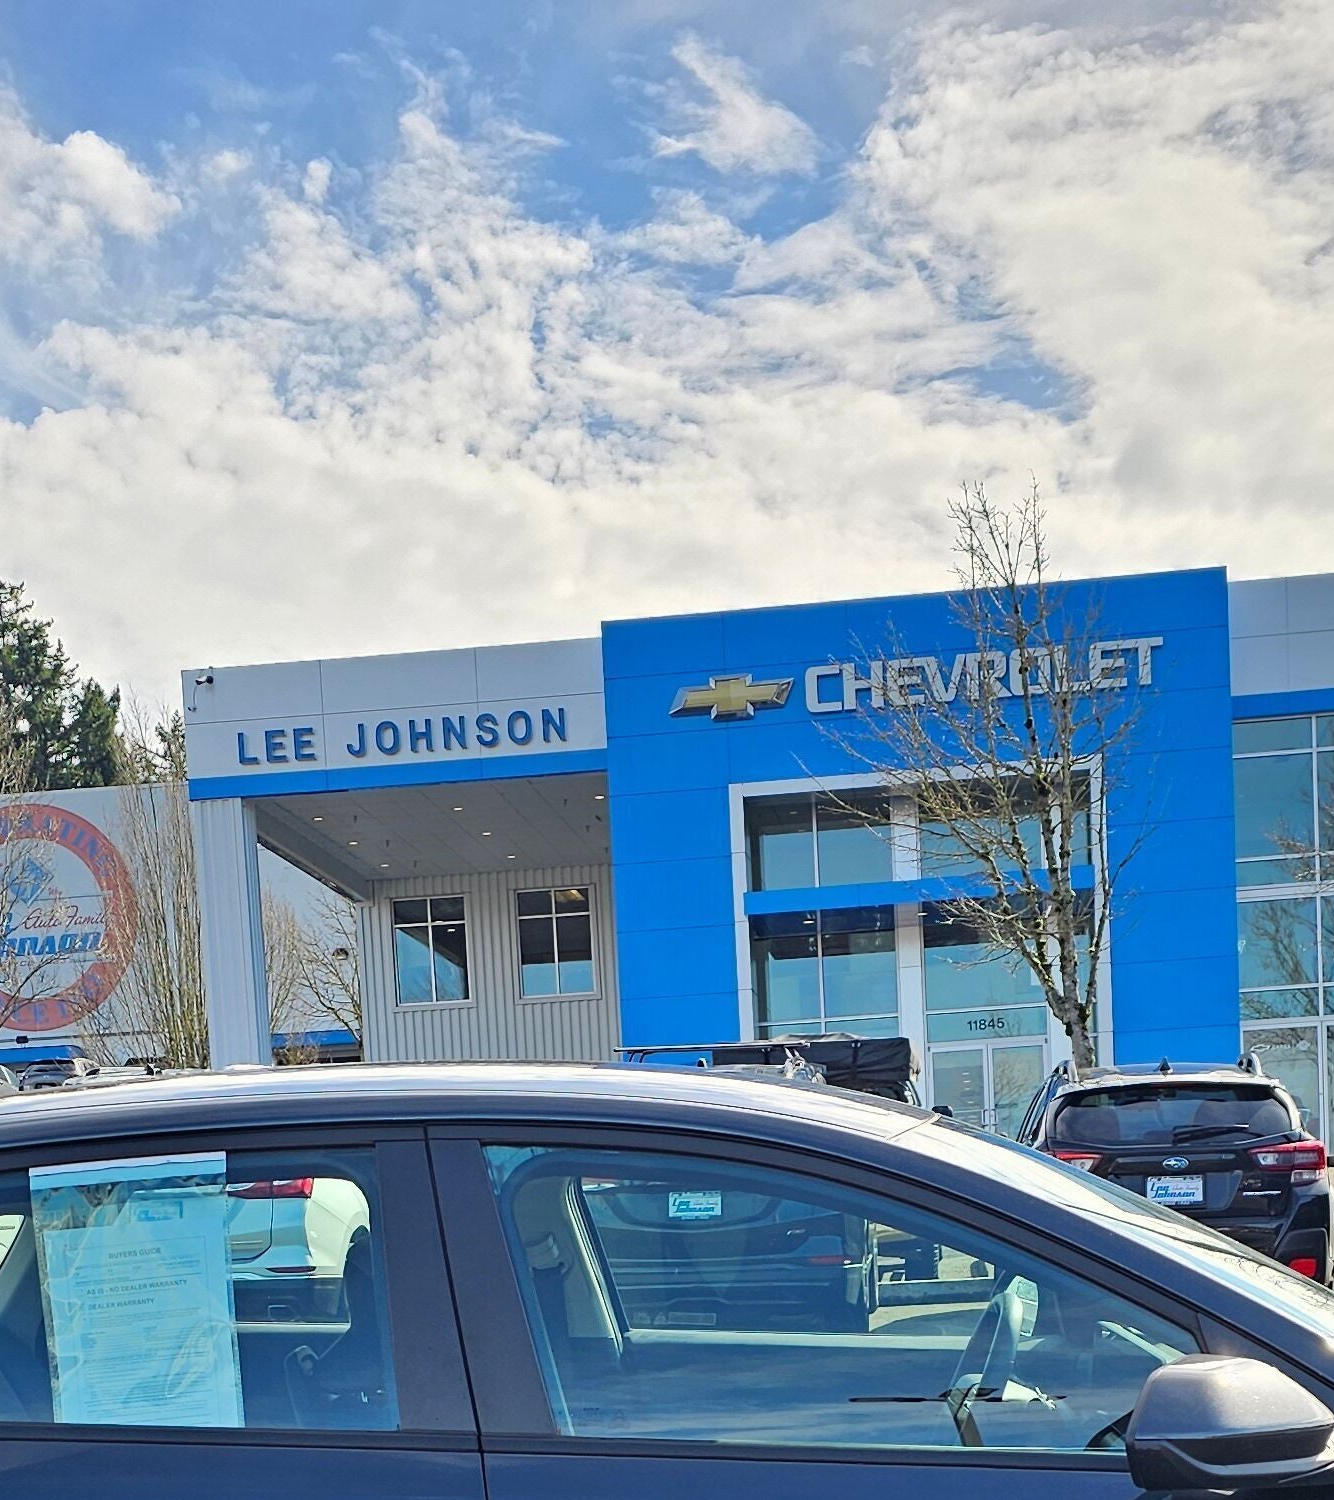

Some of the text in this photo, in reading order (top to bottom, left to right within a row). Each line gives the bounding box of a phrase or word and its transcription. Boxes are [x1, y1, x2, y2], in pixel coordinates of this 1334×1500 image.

[805, 636, 1164, 713] CHEVROLET
[237, 707, 567, 765] LEE JOHNSON
[967, 1017, 1005, 1031] 11845
[108, 1246, 163, 1260] BUYERS GUIDE
[121, 1282, 148, 1292] DEALER
[149, 1279, 188, 1289] WARRANTY
[87, 1297, 155, 1311] DEALER WARRANTY
